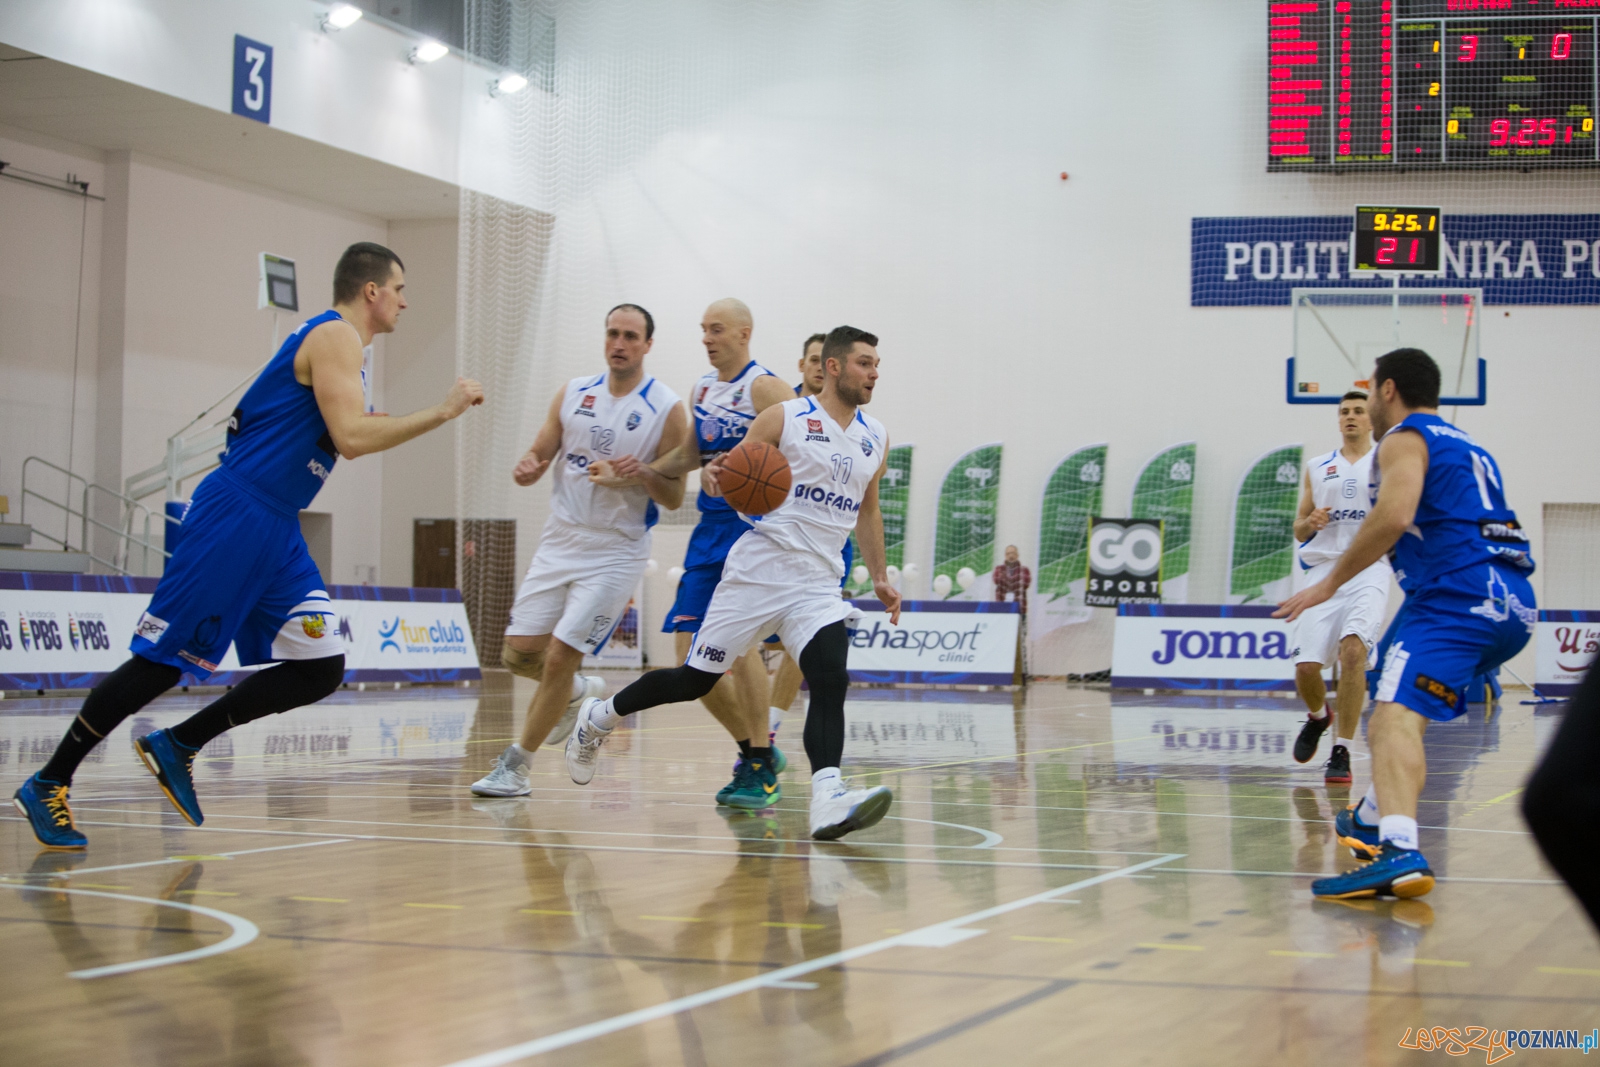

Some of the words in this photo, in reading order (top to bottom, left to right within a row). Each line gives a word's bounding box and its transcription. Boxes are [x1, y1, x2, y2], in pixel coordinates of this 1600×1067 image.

[1458, 35, 1478, 62] 3
[1550, 33, 1572, 60] 0
[243, 46, 266, 112] 3
[1428, 82, 1440, 96] 2
[1446, 119, 1459, 134] 0
[1582, 117, 1594, 132] 0
[1375, 236, 1419, 264] 21
[589, 424, 616, 456] 12
[722, 415, 746, 439] 22
[830, 452, 854, 485] 11
[1340, 478, 1358, 500] 6
[1089, 524, 1163, 576] GO
[1089, 578, 1159, 593] SPORT
[29, 619, 63, 651] PBG
[78, 620, 110, 650] PBG
[852, 621, 982, 656] ehasport
[703, 646, 726, 663] PBG
[938, 651, 975, 663] clinic
